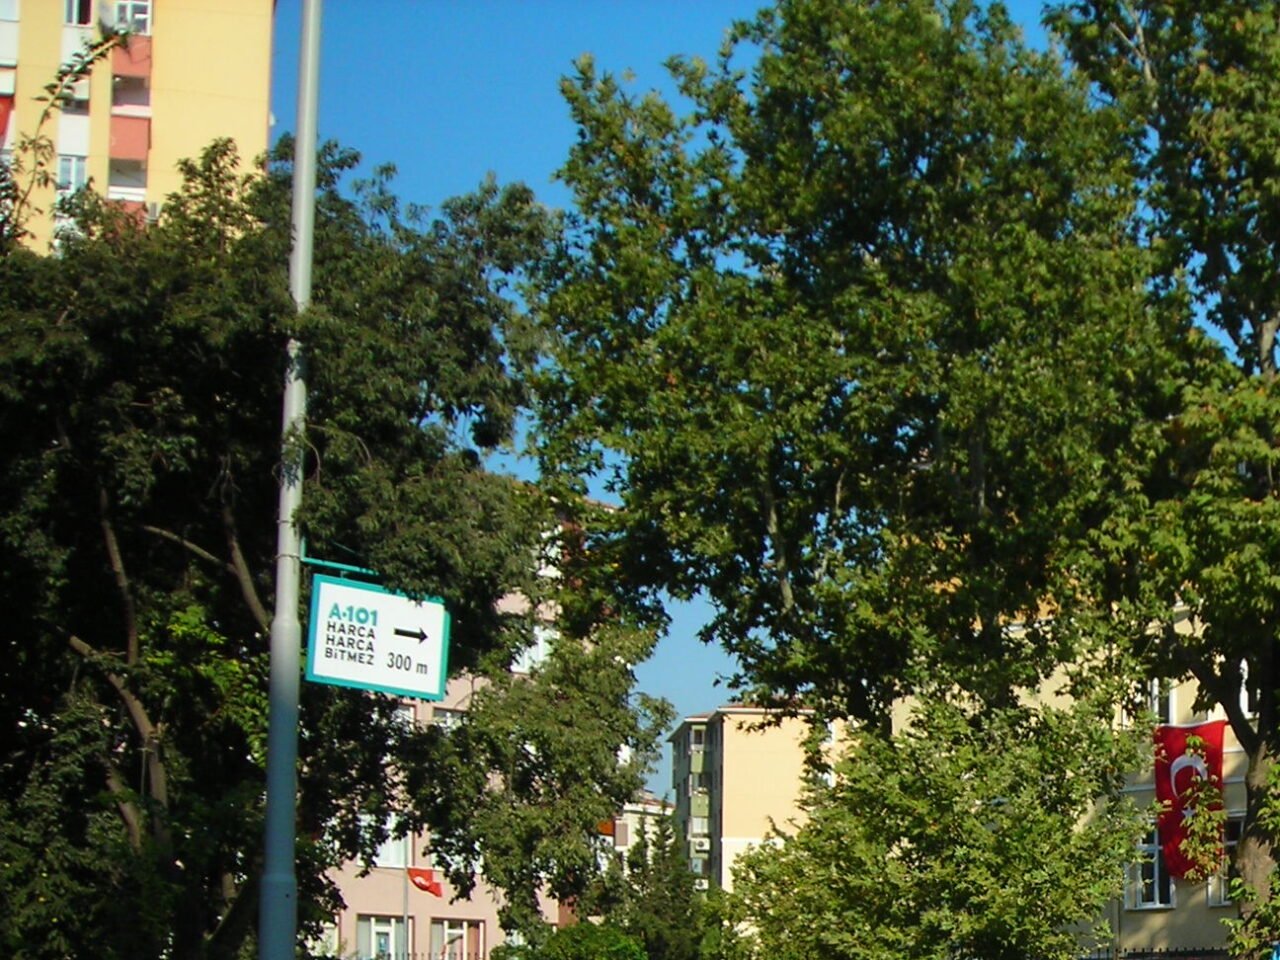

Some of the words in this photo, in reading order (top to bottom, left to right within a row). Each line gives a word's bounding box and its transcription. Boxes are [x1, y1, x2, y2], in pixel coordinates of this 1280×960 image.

[326, 620, 376, 640] HARCA
[325, 634, 375, 653] HARCA
[387, 652, 412, 672] 300
[416, 662, 428, 675] m
